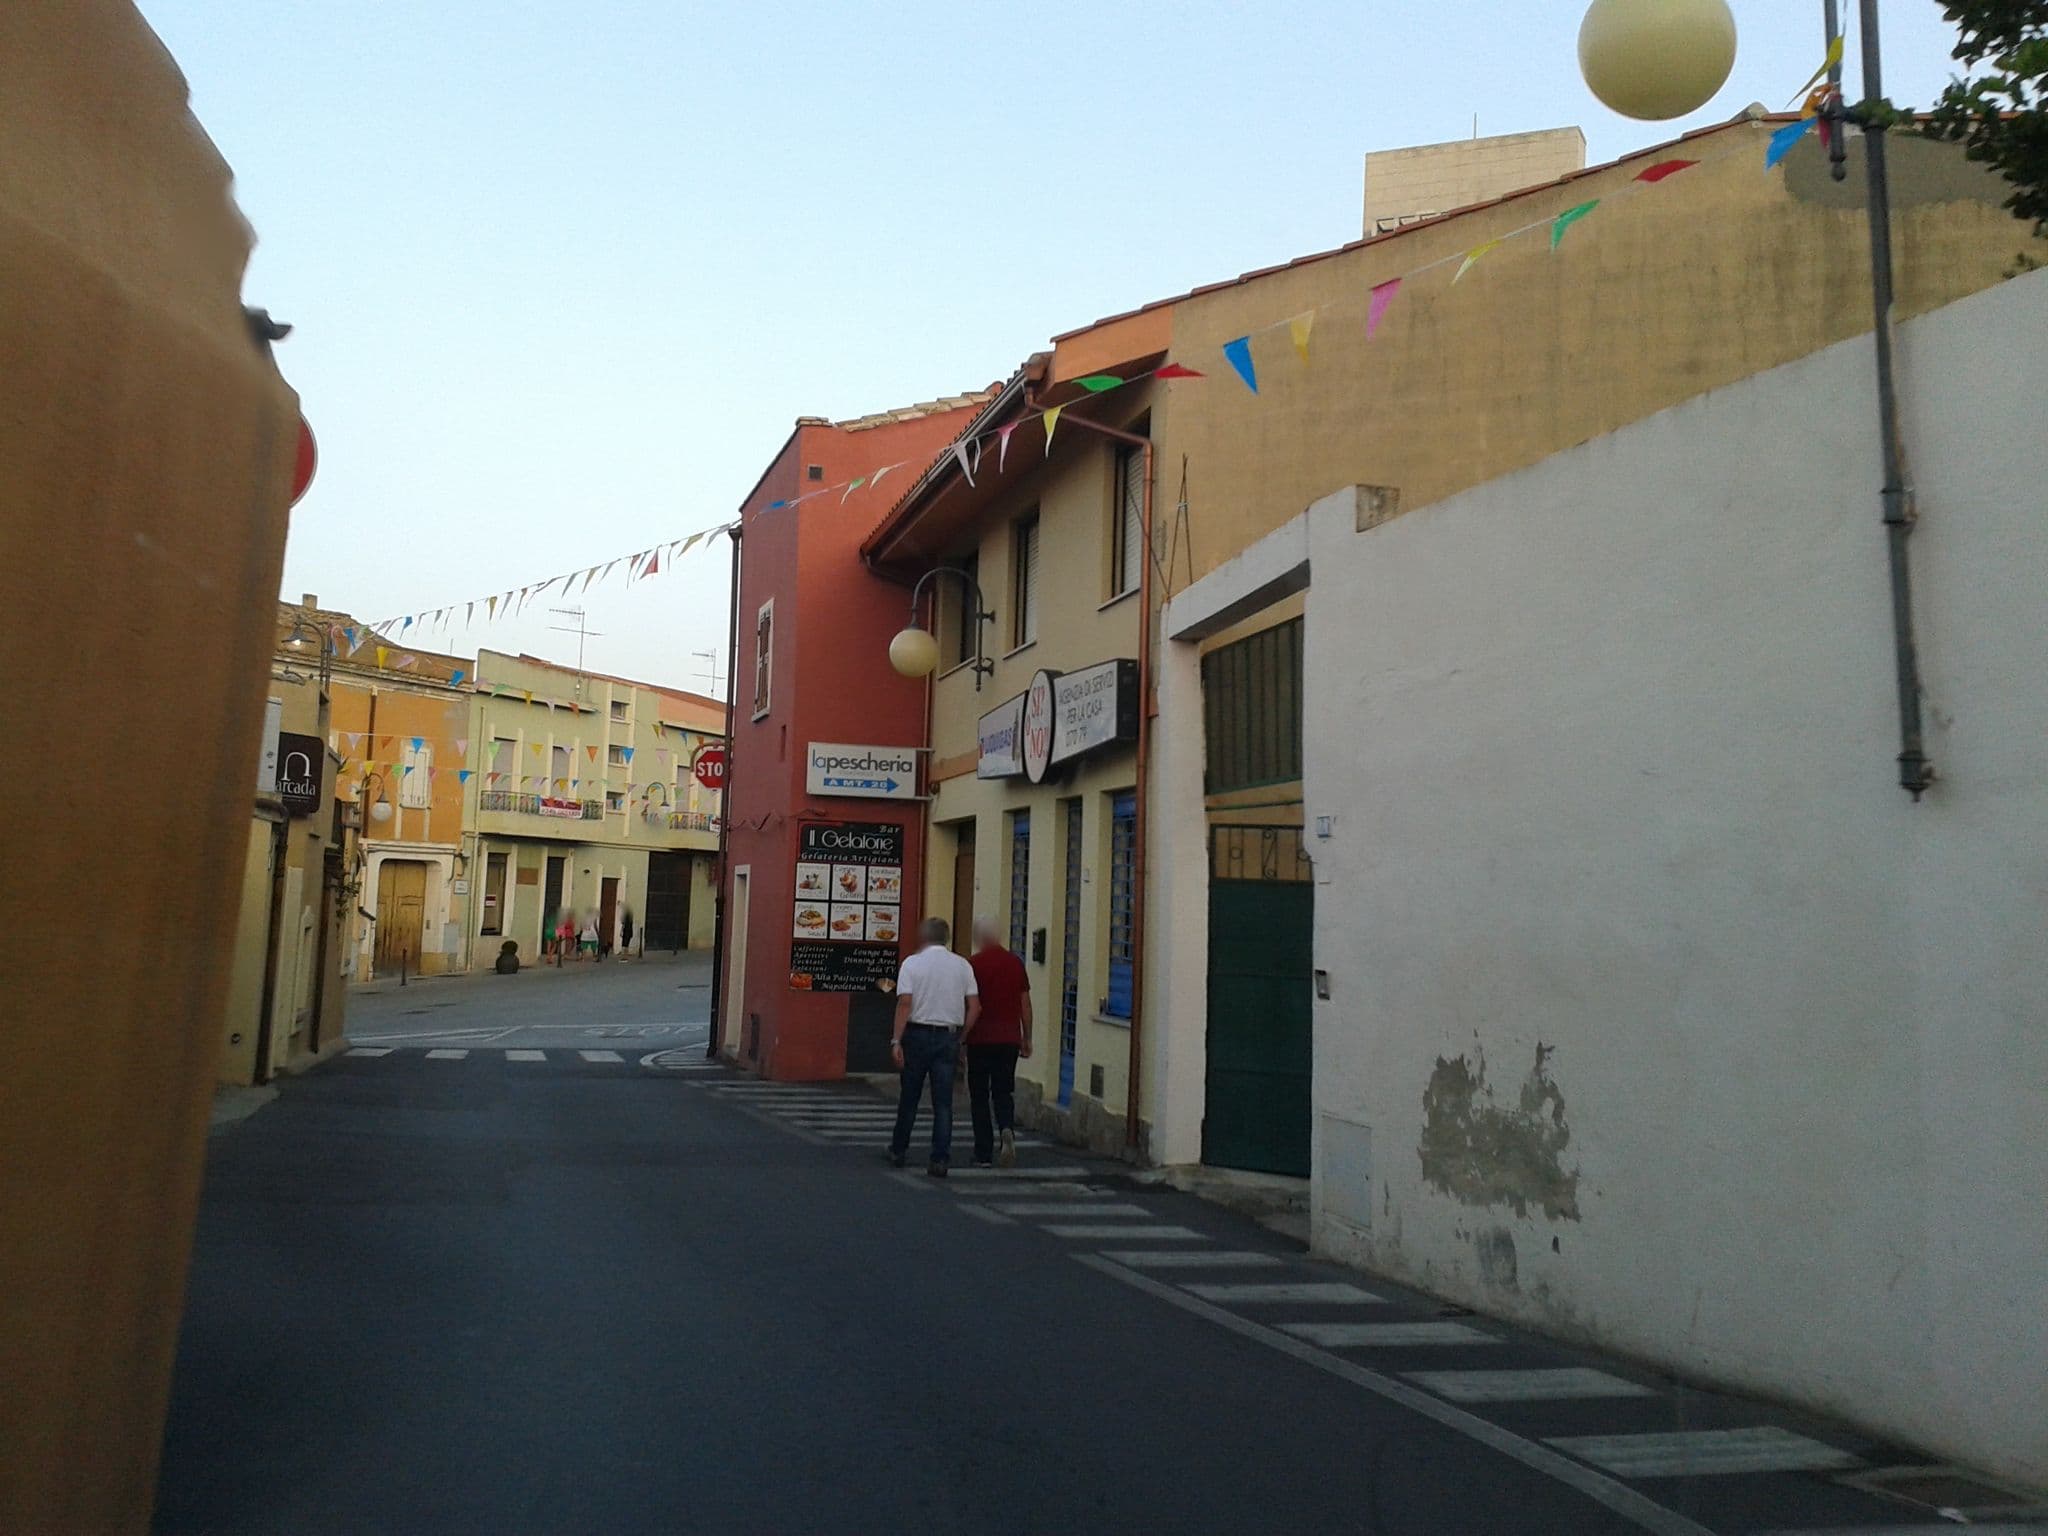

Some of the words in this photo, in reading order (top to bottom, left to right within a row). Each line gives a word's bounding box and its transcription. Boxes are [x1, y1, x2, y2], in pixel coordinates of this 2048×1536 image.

[1067, 708, 1076, 724] PER
[1078, 705, 1086, 721] LA
[1087, 699, 1102, 718] CASA
[697, 762, 723, 777] STO
[828, 778, 838, 786] A
[880, 825, 900, 834] Bar
[801, 852, 848, 861] Gelateria
[850, 854, 899, 865] Artigiana
[853, 948, 880, 957] Lounge
[833, 974, 876, 983] Pasticceria
[821, 982, 867, 992] Napoletana
